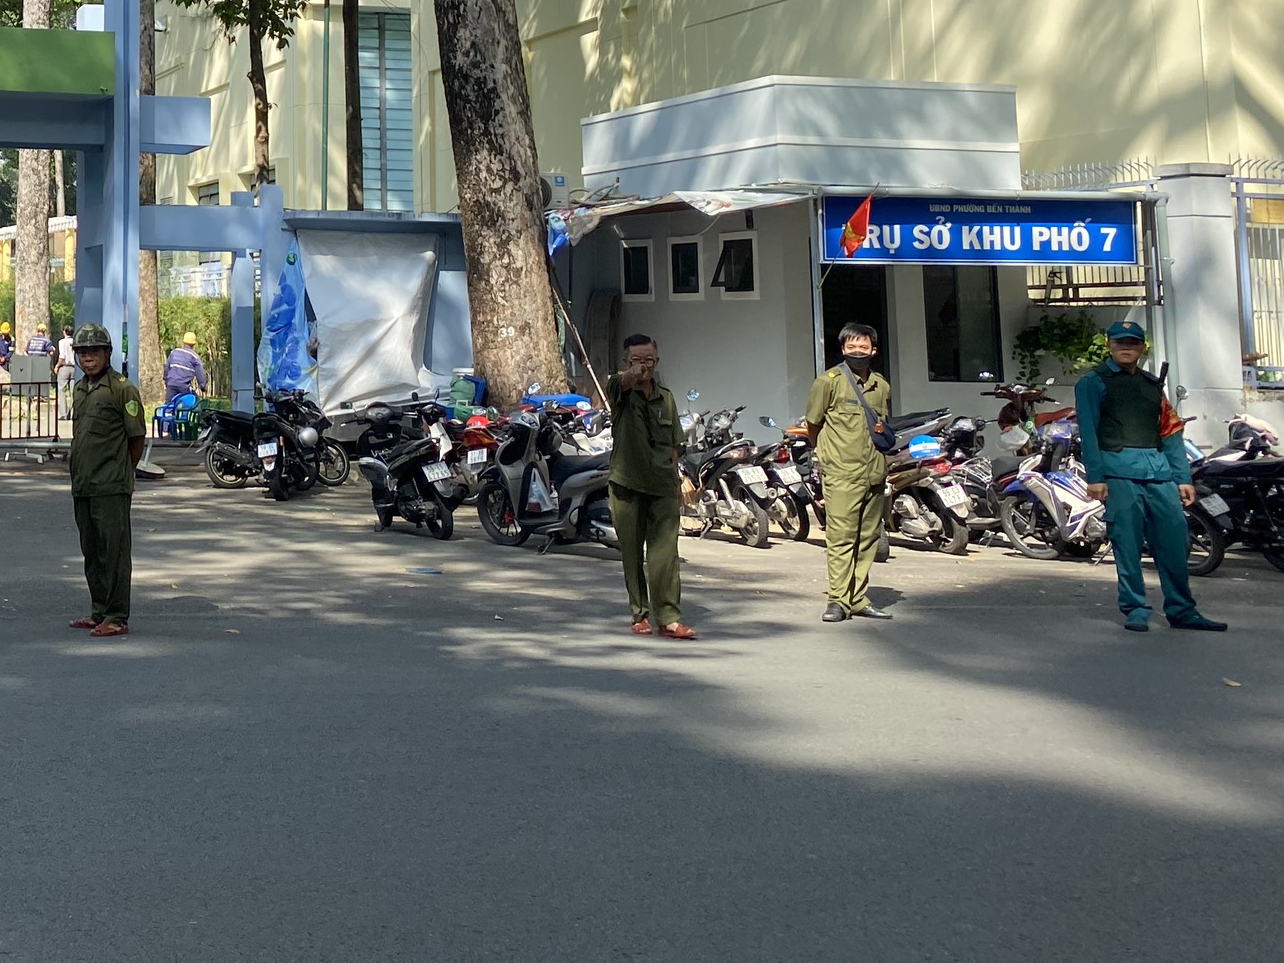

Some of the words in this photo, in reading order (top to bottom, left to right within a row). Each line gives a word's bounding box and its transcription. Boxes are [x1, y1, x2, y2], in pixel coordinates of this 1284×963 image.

[929, 204, 951, 213] UBND
[842, 224, 901, 254] RỤ
[913, 216, 952, 250] SỞ
[962, 224, 1022, 251] KHU
[1032, 217, 1093, 251] PHỐ
[1100, 227, 1117, 252] 7
[498, 325, 515, 338] 39
